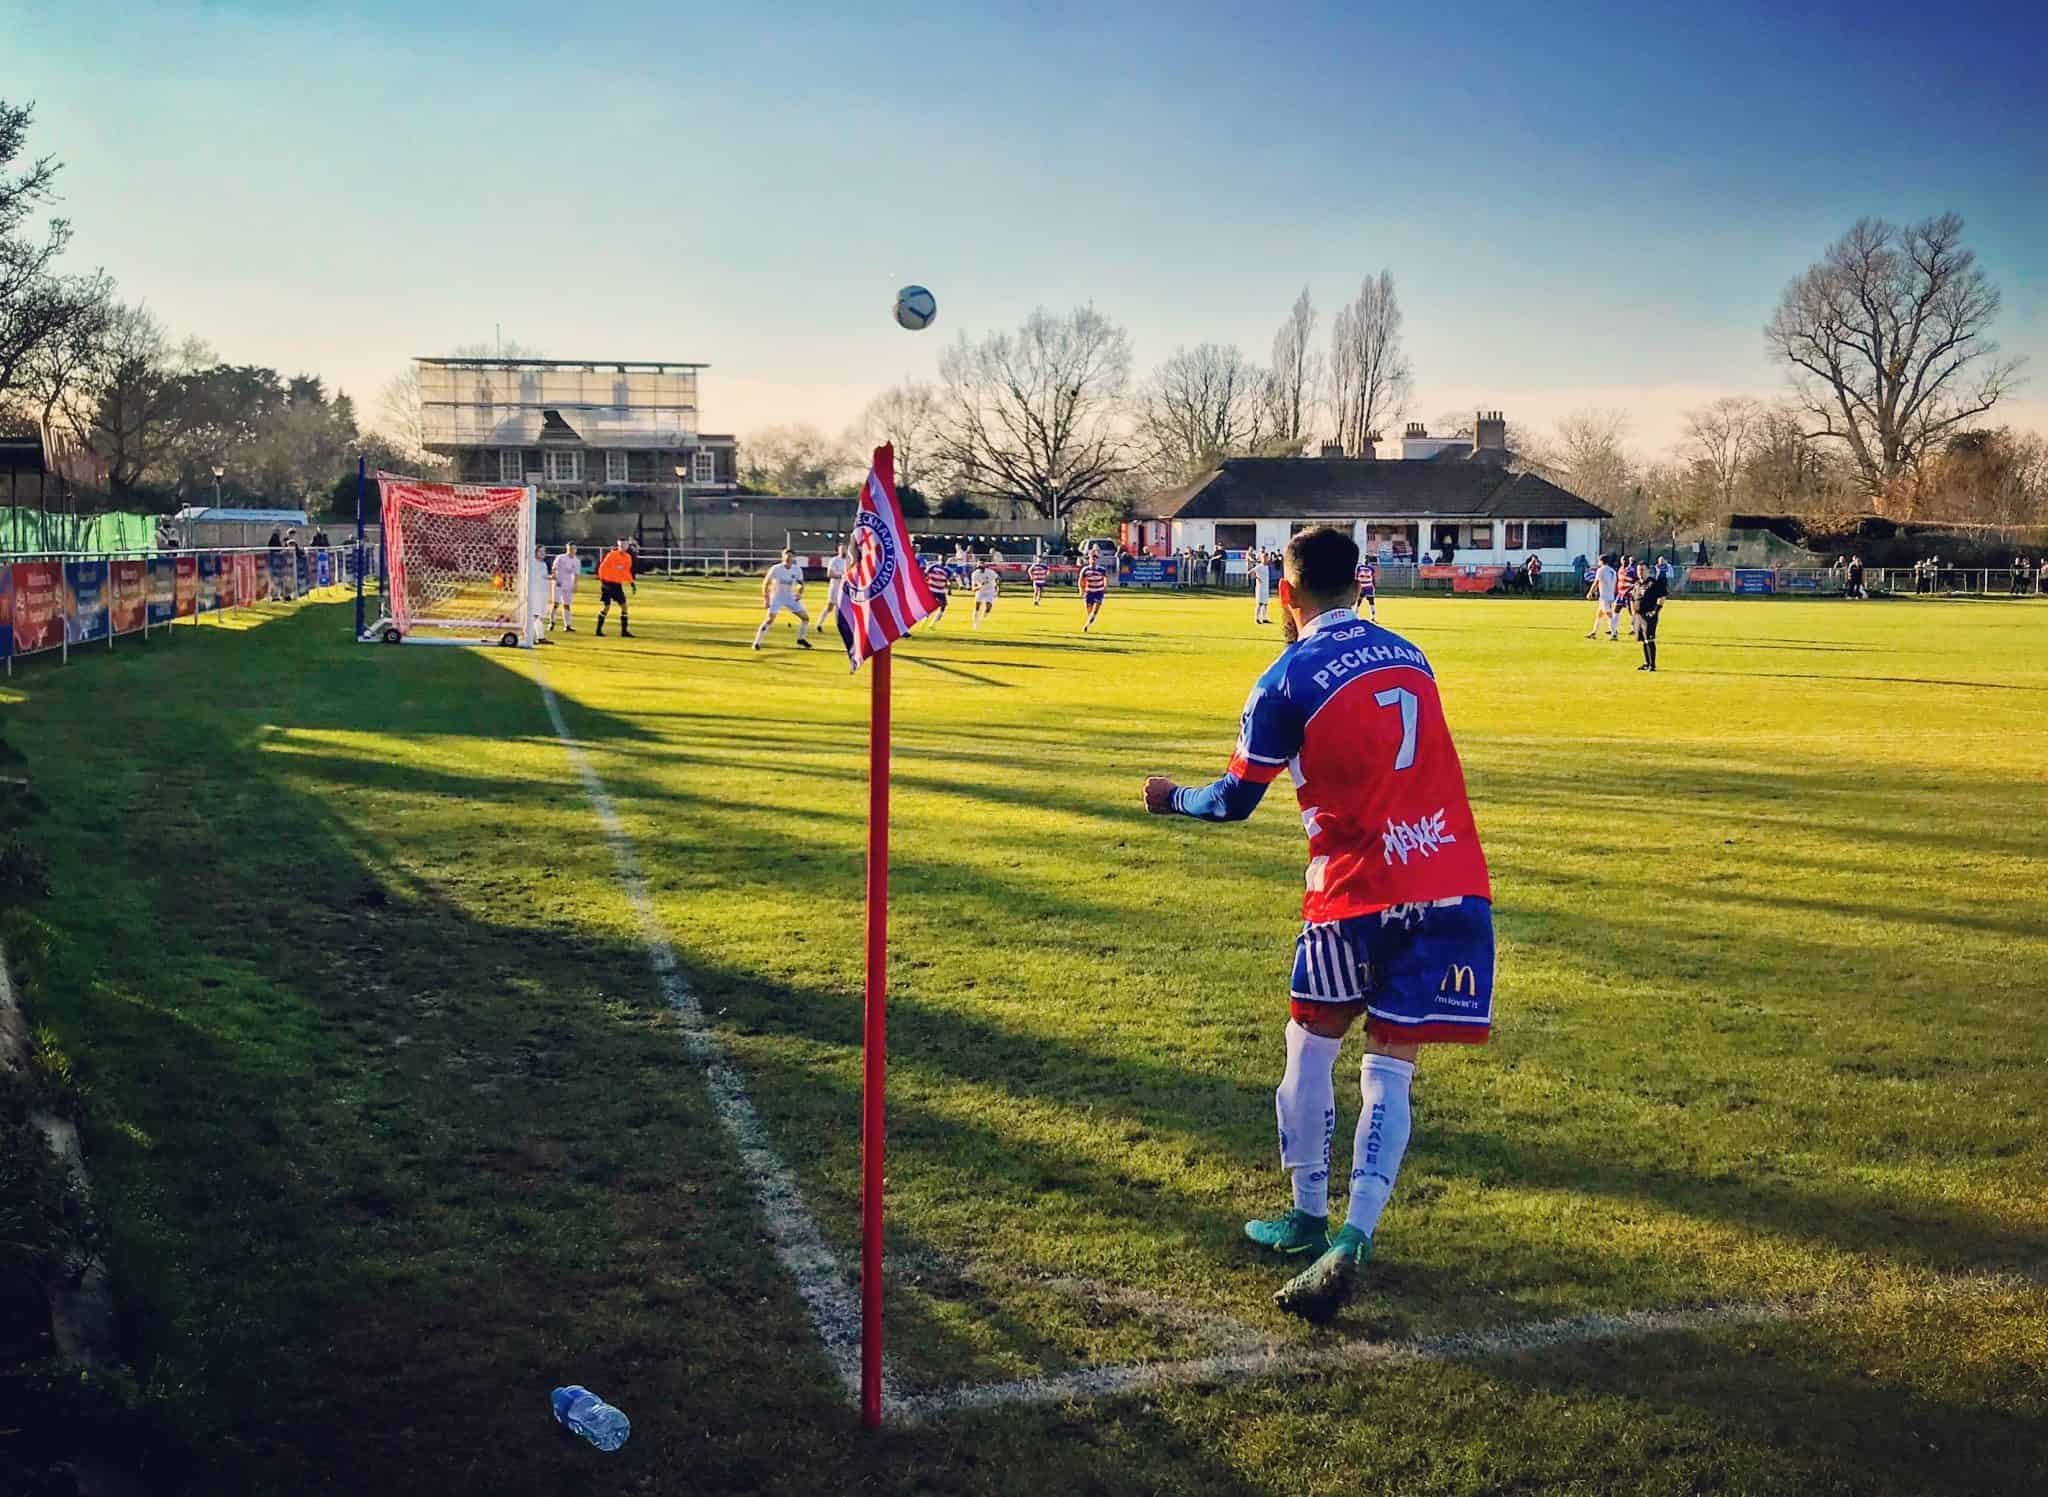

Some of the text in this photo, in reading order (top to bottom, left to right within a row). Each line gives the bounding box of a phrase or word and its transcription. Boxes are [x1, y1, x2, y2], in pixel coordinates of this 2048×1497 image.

[855, 511, 893, 550] ECKHAM
[872, 554, 893, 593] TOWN
[1312, 645, 1426, 690] PECKHAM
[1373, 687, 1418, 770] 7
